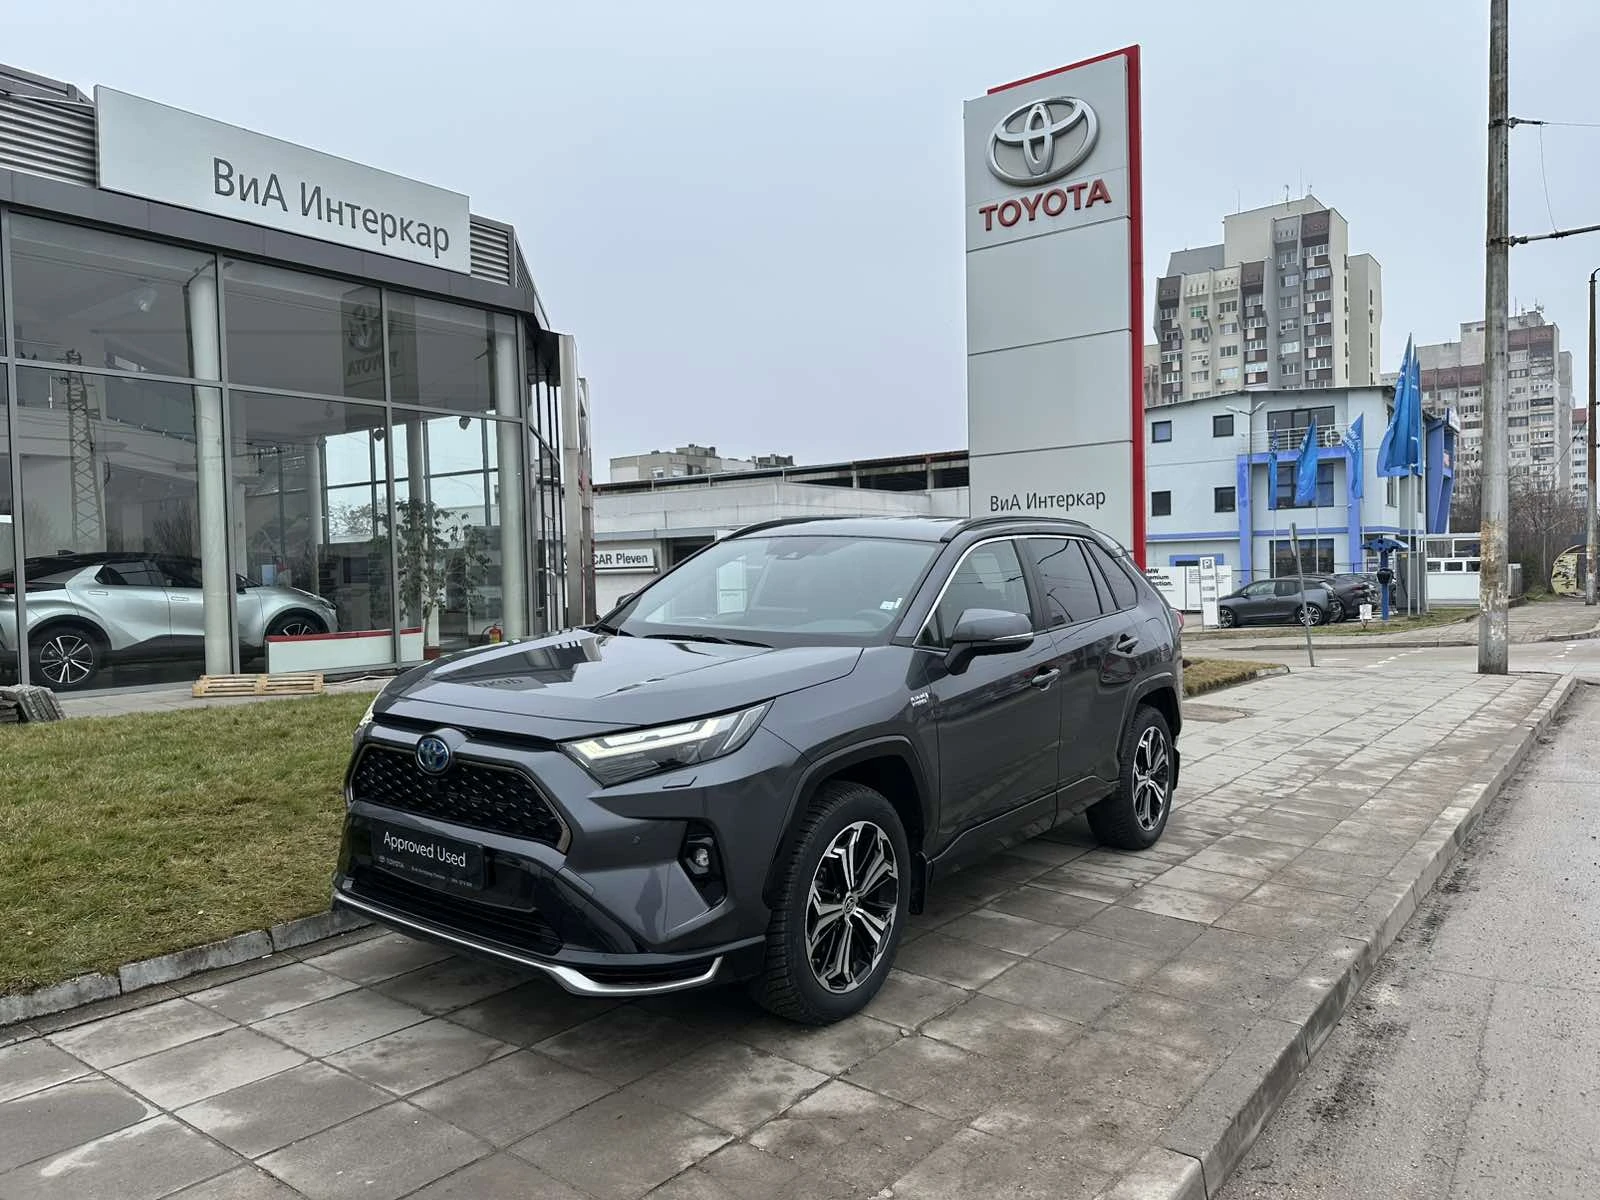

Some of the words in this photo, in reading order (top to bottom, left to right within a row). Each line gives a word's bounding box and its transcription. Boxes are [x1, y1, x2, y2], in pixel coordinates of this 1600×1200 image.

[213, 157, 288, 212] ВиА
[300, 181, 450, 258] Интеркар
[979, 178, 1112, 232] TOYOTA
[990, 494, 1021, 512] ВиА
[1026, 491, 1106, 511] Интеркар
[616, 553, 648, 564] Pleven
[383, 831, 434, 858] Approved
[437, 846, 466, 868] Used
